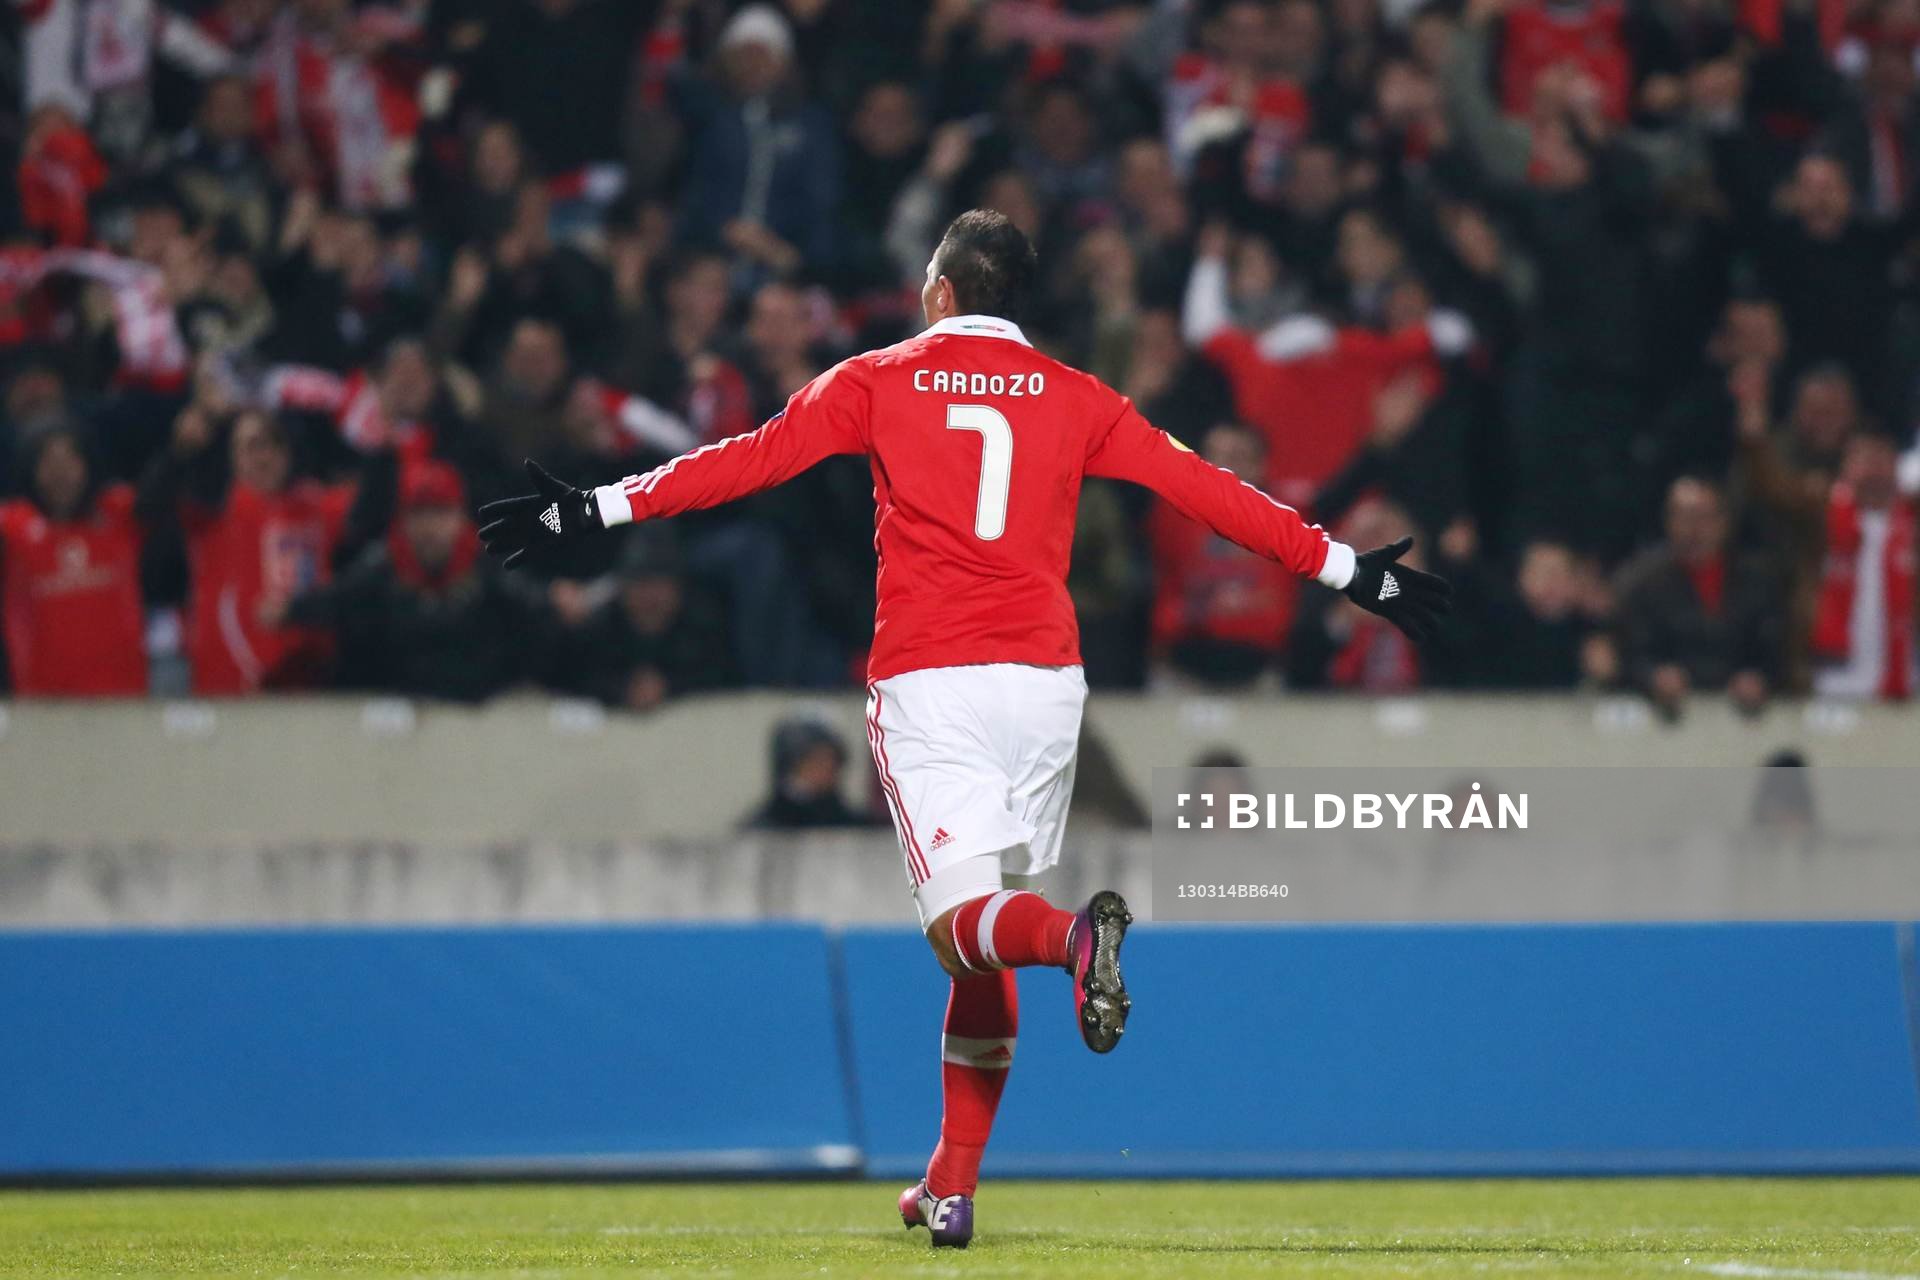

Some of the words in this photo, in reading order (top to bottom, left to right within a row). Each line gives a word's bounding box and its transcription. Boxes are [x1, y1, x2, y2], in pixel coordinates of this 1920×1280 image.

[913, 369, 1045, 396] CARDOZO
[946, 404, 1013, 541] 7
[551, 502, 562, 534] adidas
[930, 836, 956, 851] adidas
